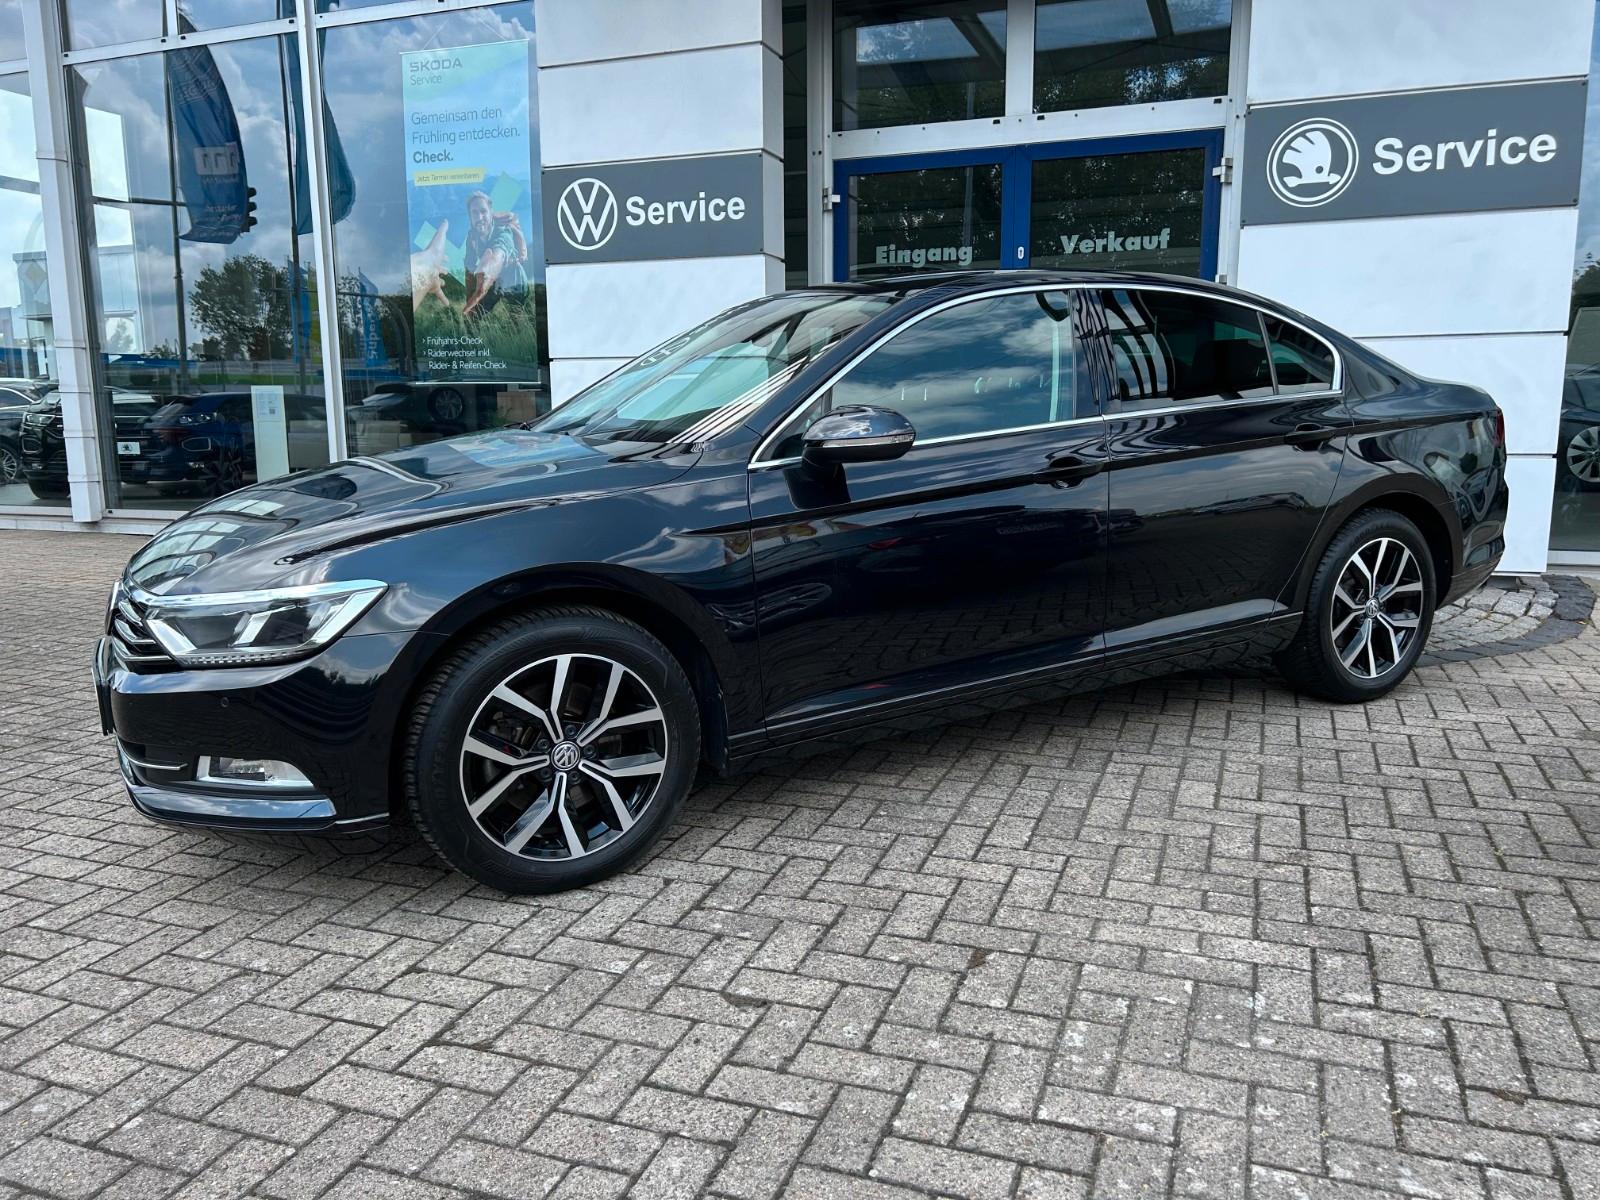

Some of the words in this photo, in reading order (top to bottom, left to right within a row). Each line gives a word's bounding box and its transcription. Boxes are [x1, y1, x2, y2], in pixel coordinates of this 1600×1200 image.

[410, 74, 442, 86] Service
[412, 109, 478, 125] Gemeinsam
[481, 106, 502, 120] den
[412, 130, 456, 145] Frühling
[458, 125, 520, 141] entdecken.
[413, 149, 454, 164] Check.
[1372, 128, 1557, 175] Service
[625, 191, 746, 226] Service
[1060, 228, 1170, 255] Verkauf
[875, 243, 973, 269] Eingang
[451, 360, 458, 369] &
